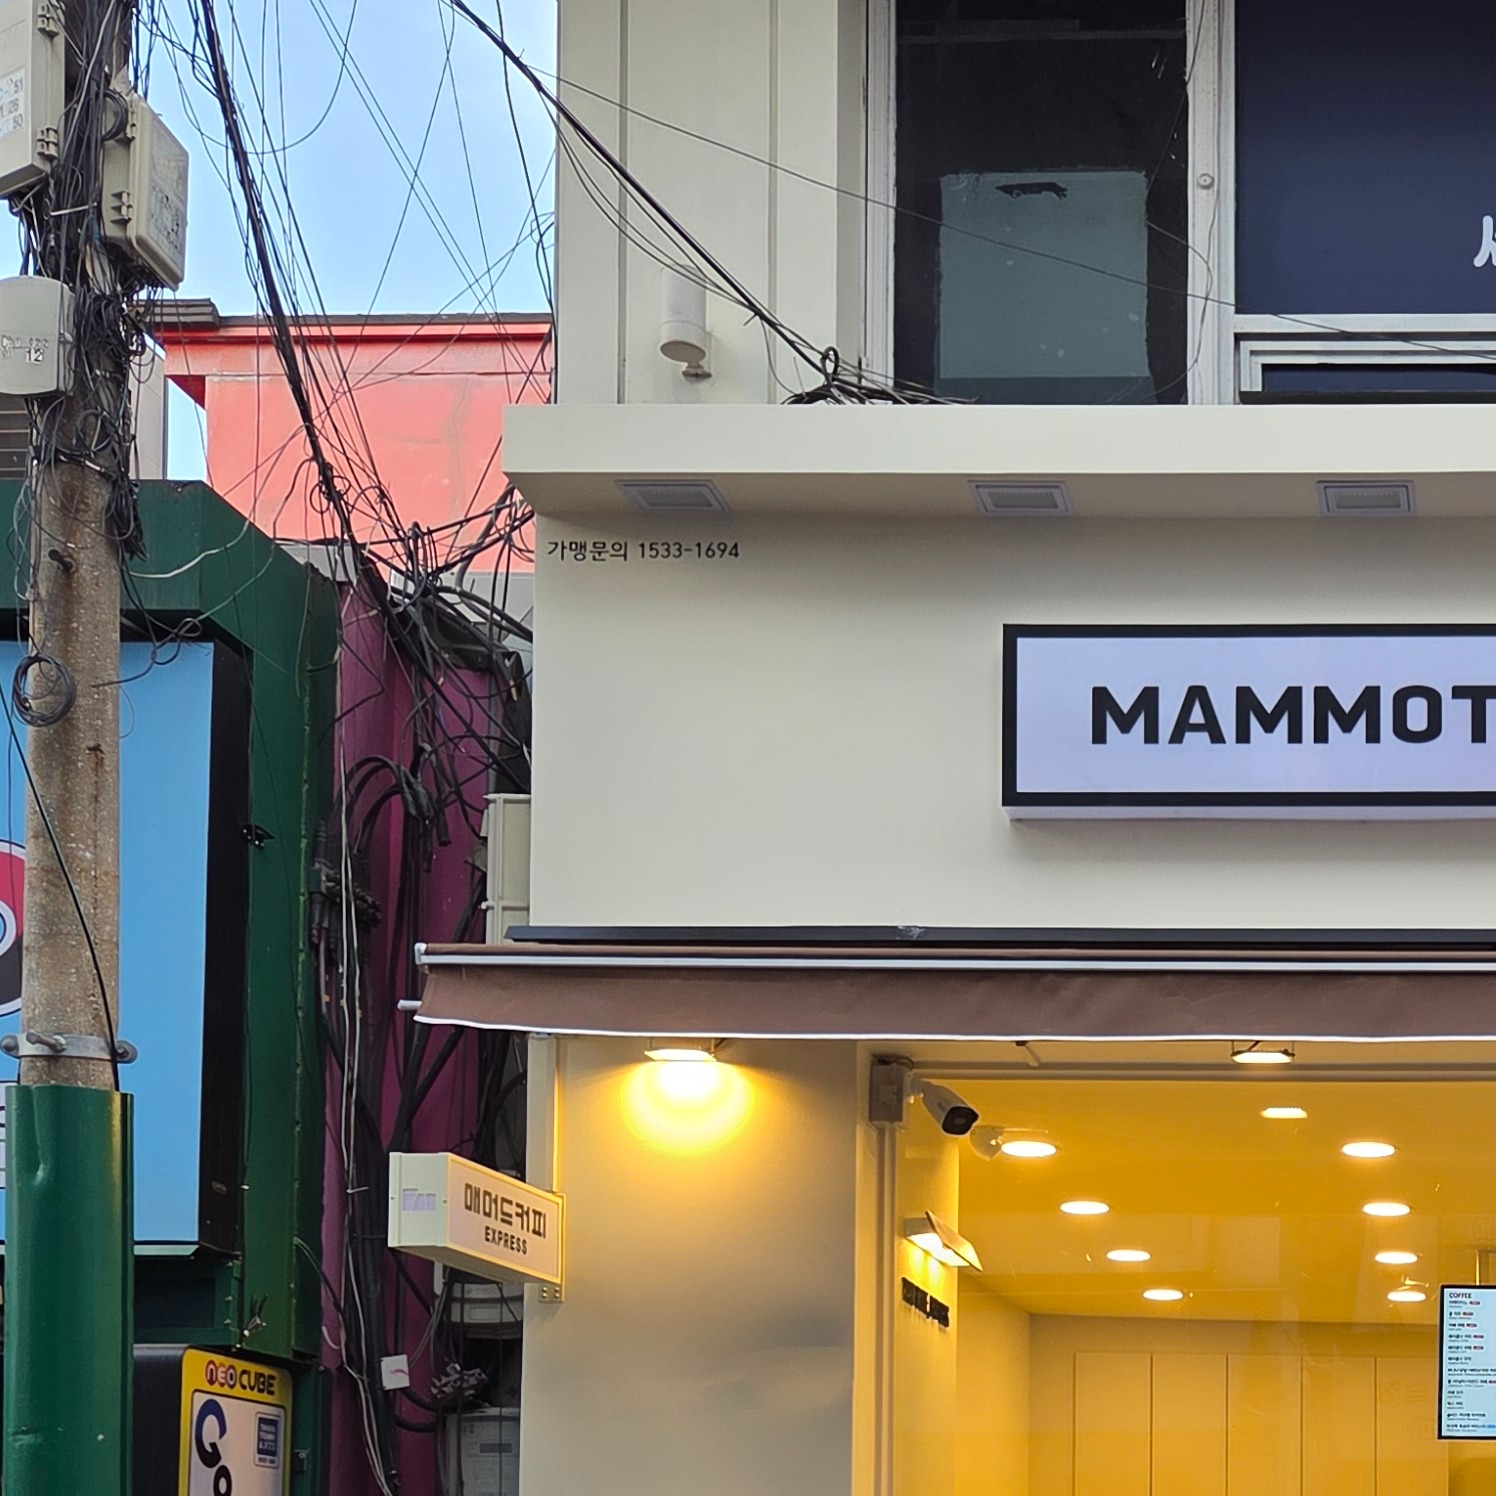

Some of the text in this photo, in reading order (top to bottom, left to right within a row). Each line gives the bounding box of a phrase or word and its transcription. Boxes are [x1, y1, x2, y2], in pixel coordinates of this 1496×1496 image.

[547, 541, 740, 561] 가맹문의 1533-1694
[464, 1183, 547, 1239] 매머드커피
[485, 1226, 528, 1255] EXPRESS
[239, 1369, 276, 1396] CUBE
